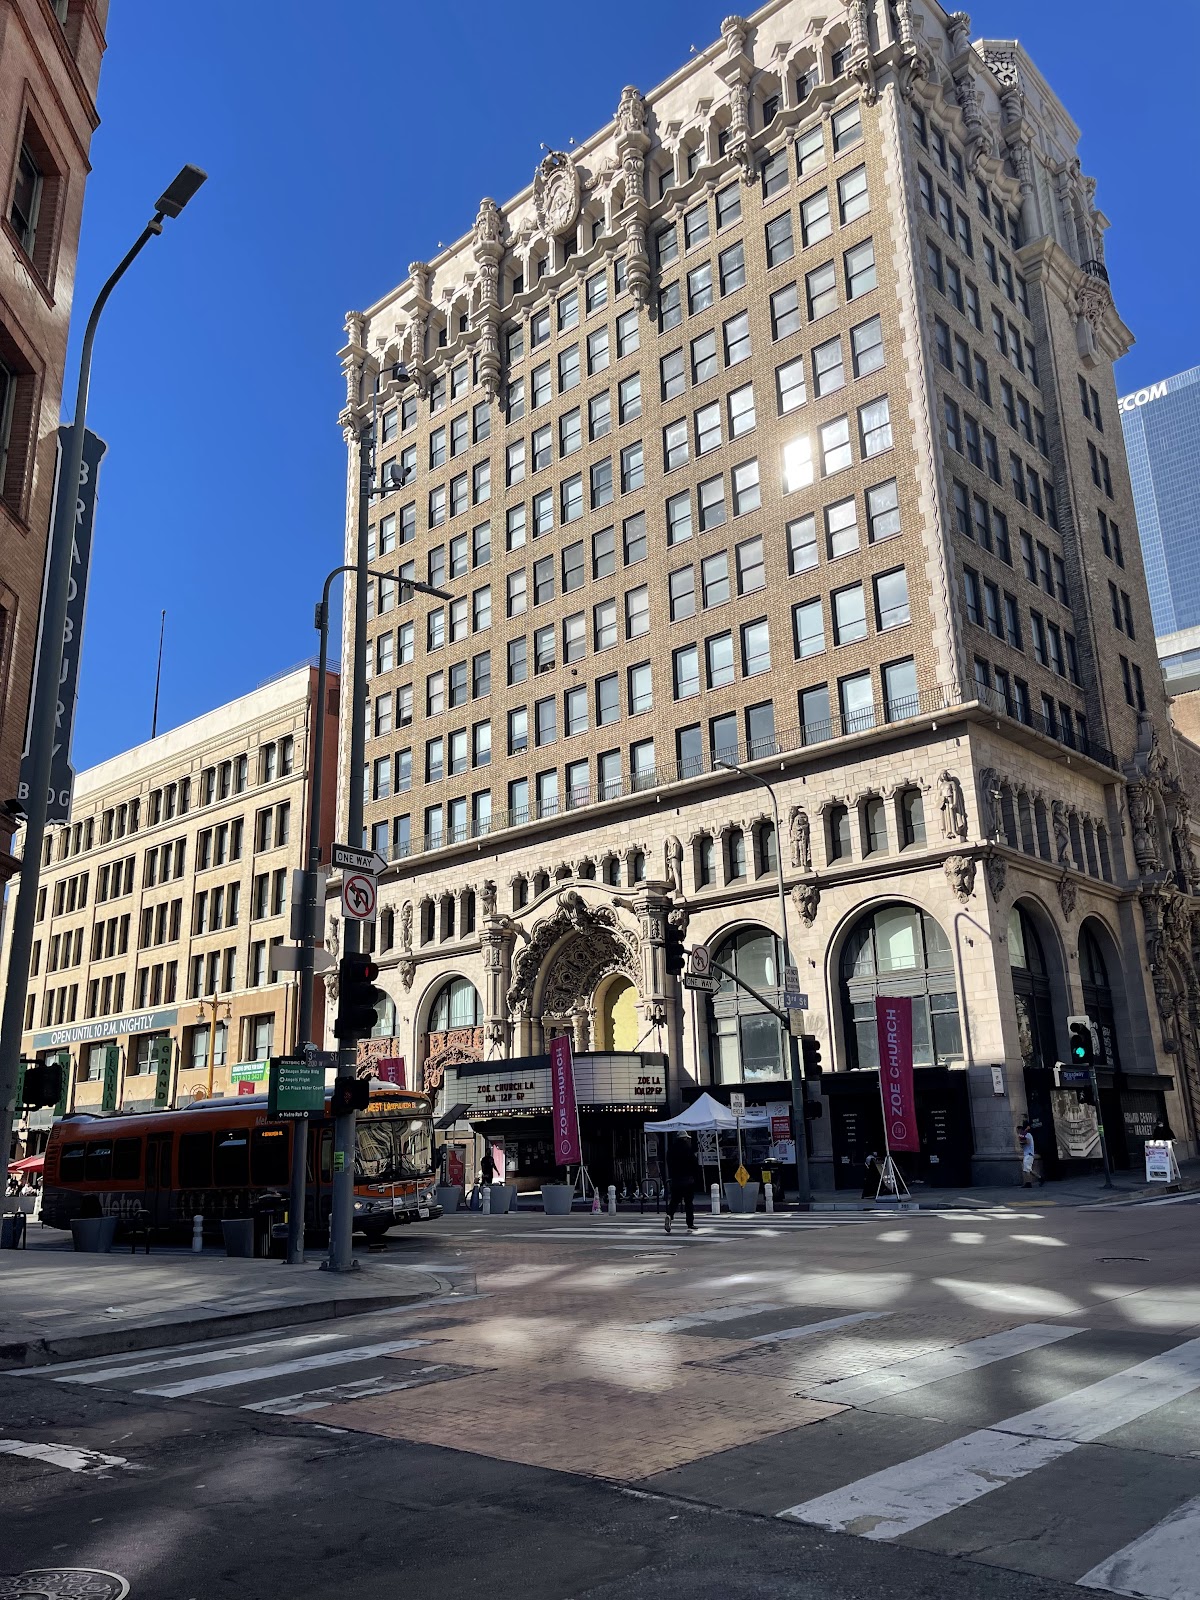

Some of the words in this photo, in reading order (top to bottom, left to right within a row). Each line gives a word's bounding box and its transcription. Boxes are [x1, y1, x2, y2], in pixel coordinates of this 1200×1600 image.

[17, 781, 70, 807] BDG
[338, 852, 354, 864] ONE
[356, 856, 373, 868] WAY
[687, 977, 698, 986] ONE
[701, 979, 713, 988] WAY
[786, 995, 797, 1006] 3rd
[799, 997, 807, 1006] St
[51, 1032, 73, 1045] OPEN
[72, 1026, 93, 1041] UNTIL
[94, 1025, 102, 1037] 10
[102, 1022, 118, 1036] P.M.
[119, 1014, 154, 1033] NIGHTLY
[886, 1008, 900, 1079] CHURCH
[330, 1053, 338, 1062] St
[105, 1050, 117, 1109] CENTRAL
[158, 1045, 169, 1100] GRAND
[556, 1047, 567, 1104] CHURCH
[638, 1076, 651, 1085] ZOE
[651, 1076, 661, 1085] LA
[477, 1084, 491, 1094] ZOE
[495, 1083, 522, 1092] CHURCH
[524, 1081, 534, 1090] LA
[485, 1094, 496, 1103] 10A
[501, 1093, 513, 1102] 12P
[516, 1092, 525, 1101] 6P
[890, 1083, 904, 1117] ZOE
[560, 1107, 568, 1136] ZOE
[99, 1192, 143, 1219] Metro
